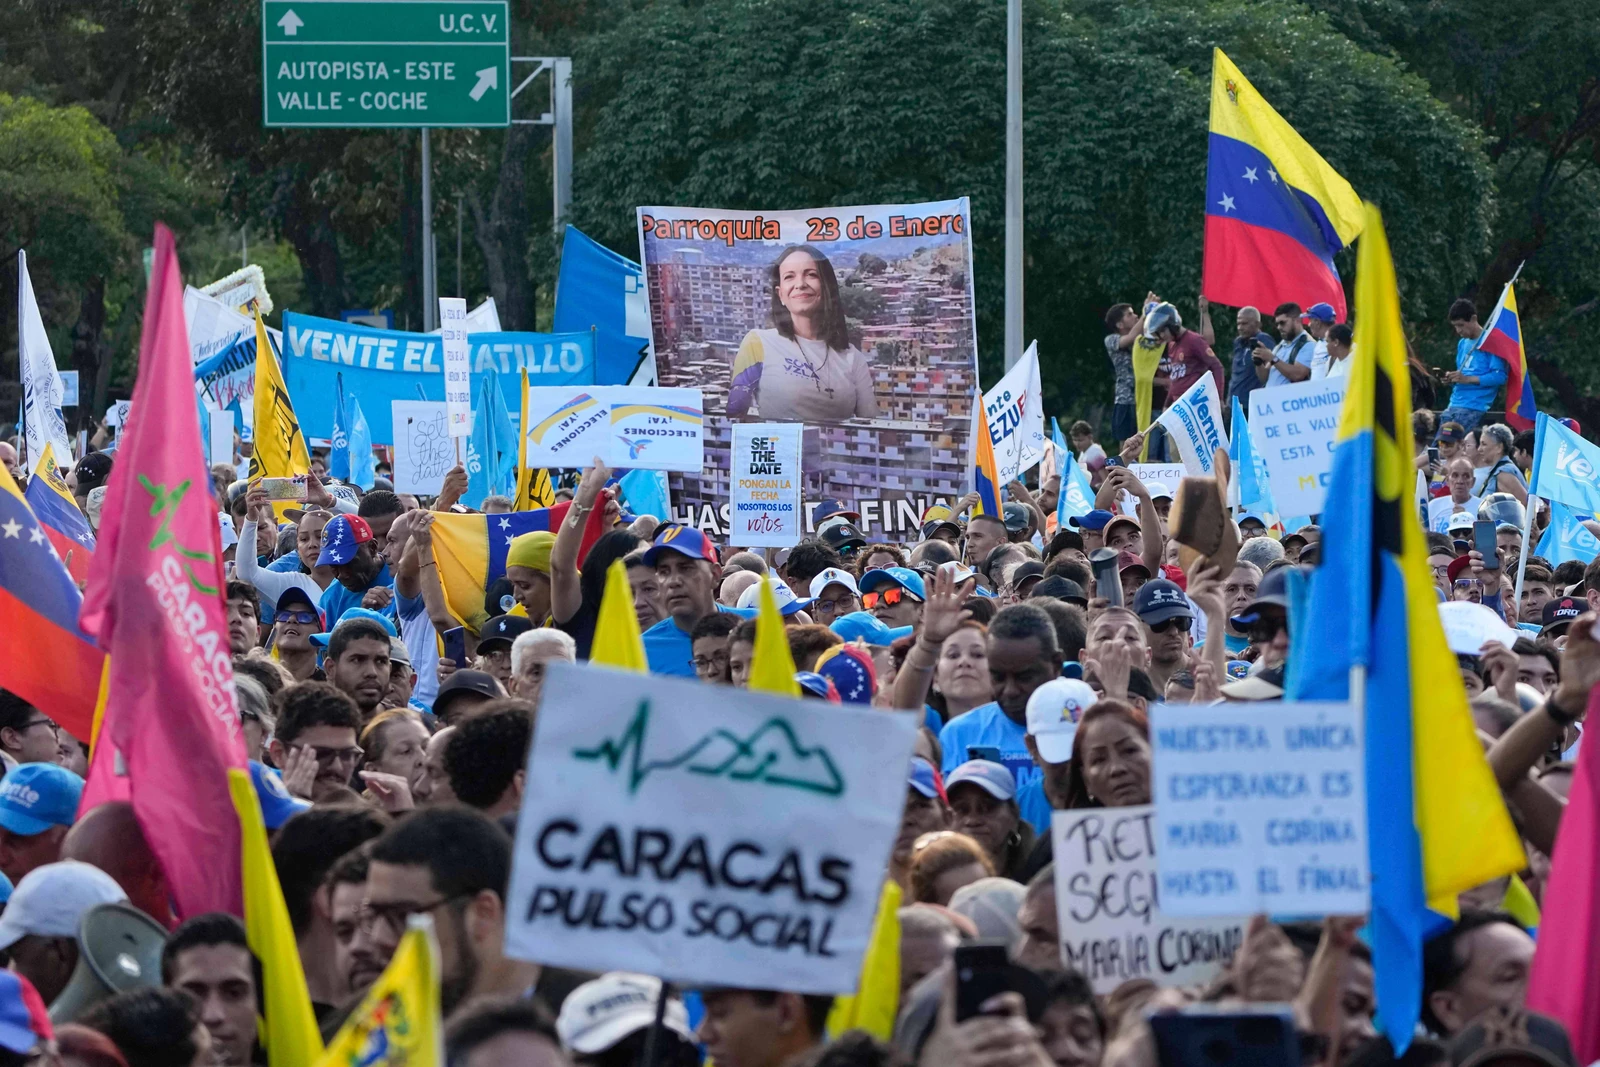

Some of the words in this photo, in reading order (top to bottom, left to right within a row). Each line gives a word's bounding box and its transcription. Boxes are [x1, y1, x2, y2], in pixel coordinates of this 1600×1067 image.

[439, 14, 497, 33] U.C.V.
[642, 214, 780, 247] Parroquia
[806, 217, 840, 242] 23
[846, 215, 882, 241] de
[288, 326, 397, 370] VENTE
[403, 341, 440, 373] EL
[986, 390, 1011, 418] nte
[1257, 403, 1274, 417] LA
[551, 409, 608, 453] ELECCIONES
[1188, 384, 1220, 454] Vente
[1265, 425, 1281, 438] DE
[1287, 422, 1301, 436] EL
[1309, 416, 1340, 431] VALL
[624, 427, 697, 438] ELECCIONES
[751, 437, 779, 450] SET
[1172, 404, 1199, 446] CRISTOBAL
[1195, 445, 1211, 472] ROJAS
[751, 451, 775, 462] THE
[1281, 445, 1315, 460] ESTA
[412, 459, 452, 485] date
[750, 463, 782, 475] DATE
[1135, 466, 1181, 480] iberen
[740, 479, 778, 489] PONGAN
[780, 479, 791, 489] LA
[751, 491, 779, 500] FECHA
[737, 503, 777, 511] NOSOTROS
[778, 504, 793, 512] LOS
[747, 512, 784, 534] votos
[1553, 608, 1579, 617] TORO
[1157, 725, 1270, 750] NUESTRA
[1167, 771, 1309, 799] ESPERANZA
[1321, 770, 1353, 798] ES
[1065, 812, 1157, 866] RET
[1265, 812, 1357, 848] CORINA
[535, 817, 853, 908] CARACAS
[1163, 867, 1240, 898] HASTA
[1257, 867, 1283, 894] EL
[1298, 862, 1364, 892] FINAL
[1068, 870, 1160, 925] SEG
[527, 883, 676, 934] PULSO
[686, 899, 837, 957] SOCIAL
